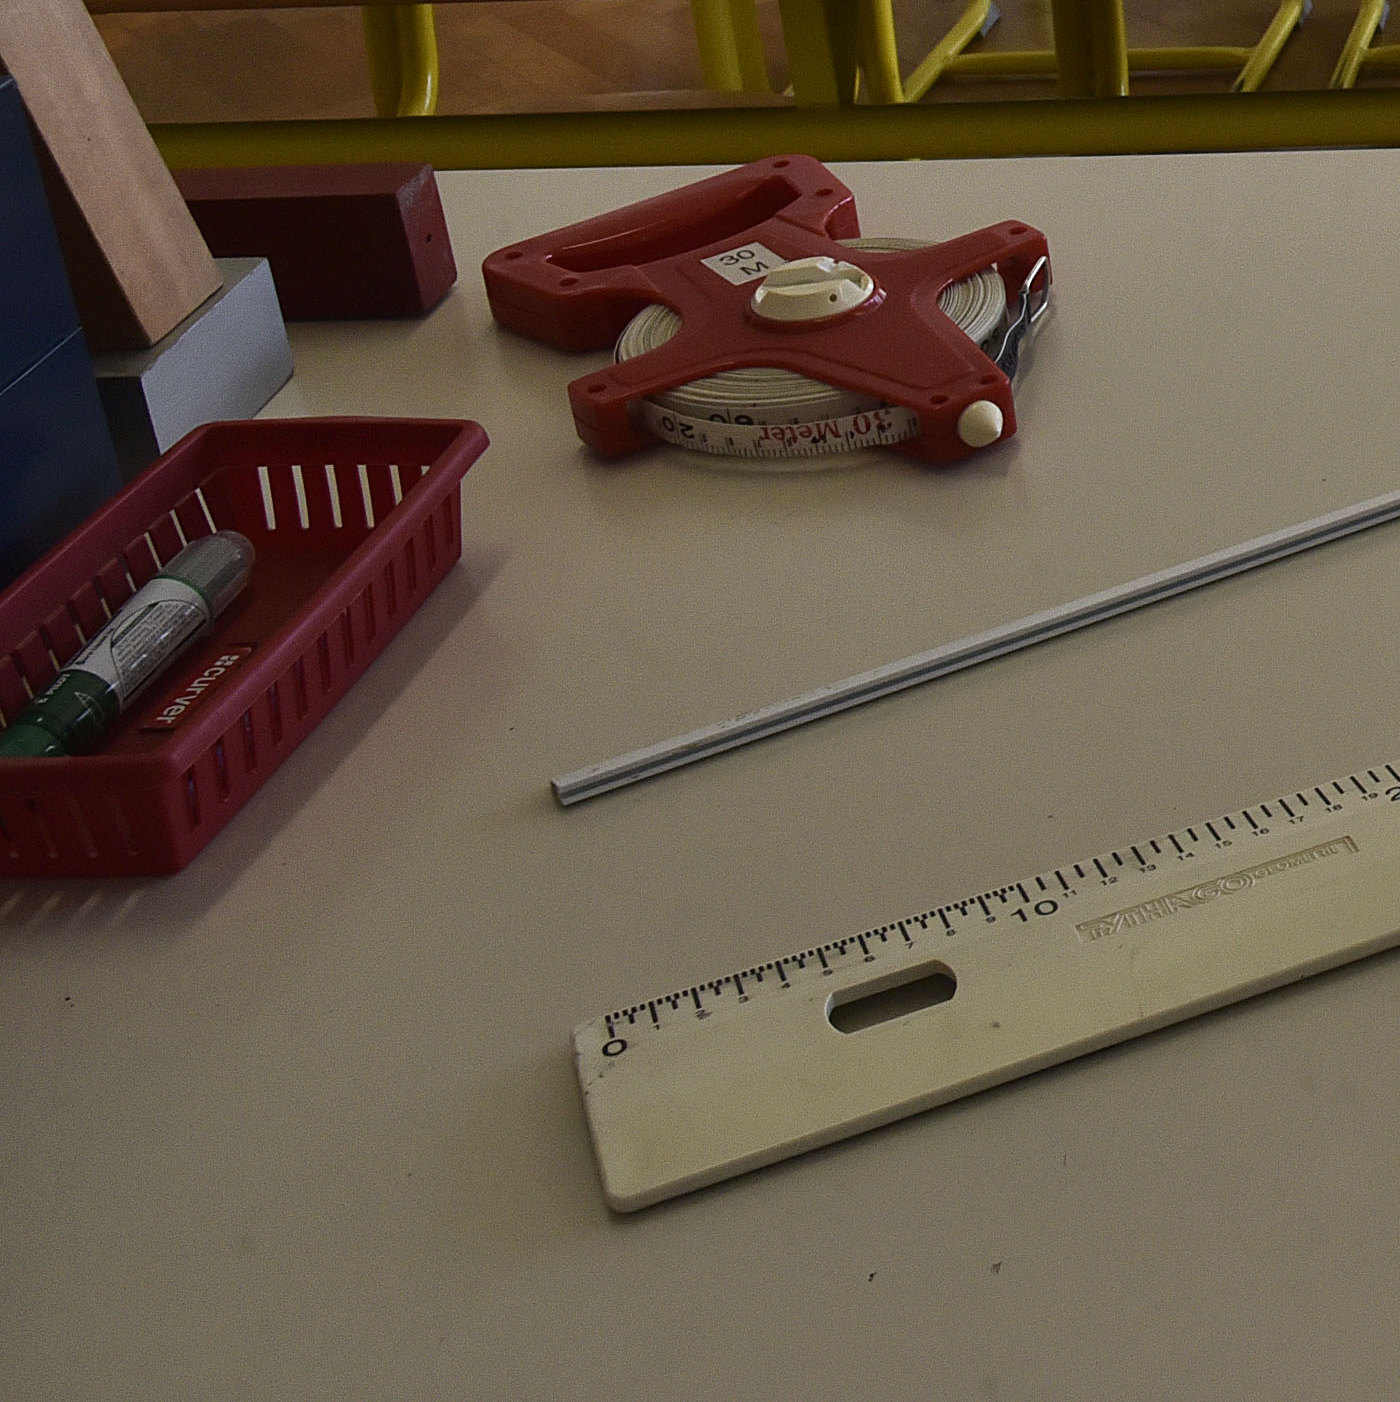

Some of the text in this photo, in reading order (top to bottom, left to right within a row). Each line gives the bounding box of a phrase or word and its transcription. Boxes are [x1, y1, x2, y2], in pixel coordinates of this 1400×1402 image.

[717, 248, 756, 268] 30
[738, 261, 771, 278] M
[662, 416, 695, 439] 20
[760, 409, 894, 443] 30 Meter
[155, 664, 227, 726] curver
[602, 1038, 627, 1056] 0
[1010, 899, 1059, 922] 10
[1062, 890, 1078, 898] 11
[1100, 876, 1119, 886] 12
[1139, 864, 1156, 873] 13
[1177, 852, 1195, 861] 14
[1214, 840, 1232, 849] 15
[1251, 828, 1270, 836] 16
[1289, 816, 1305, 825] 17
[1325, 804, 1343, 813] 18
[1361, 792, 1378, 802] 19
